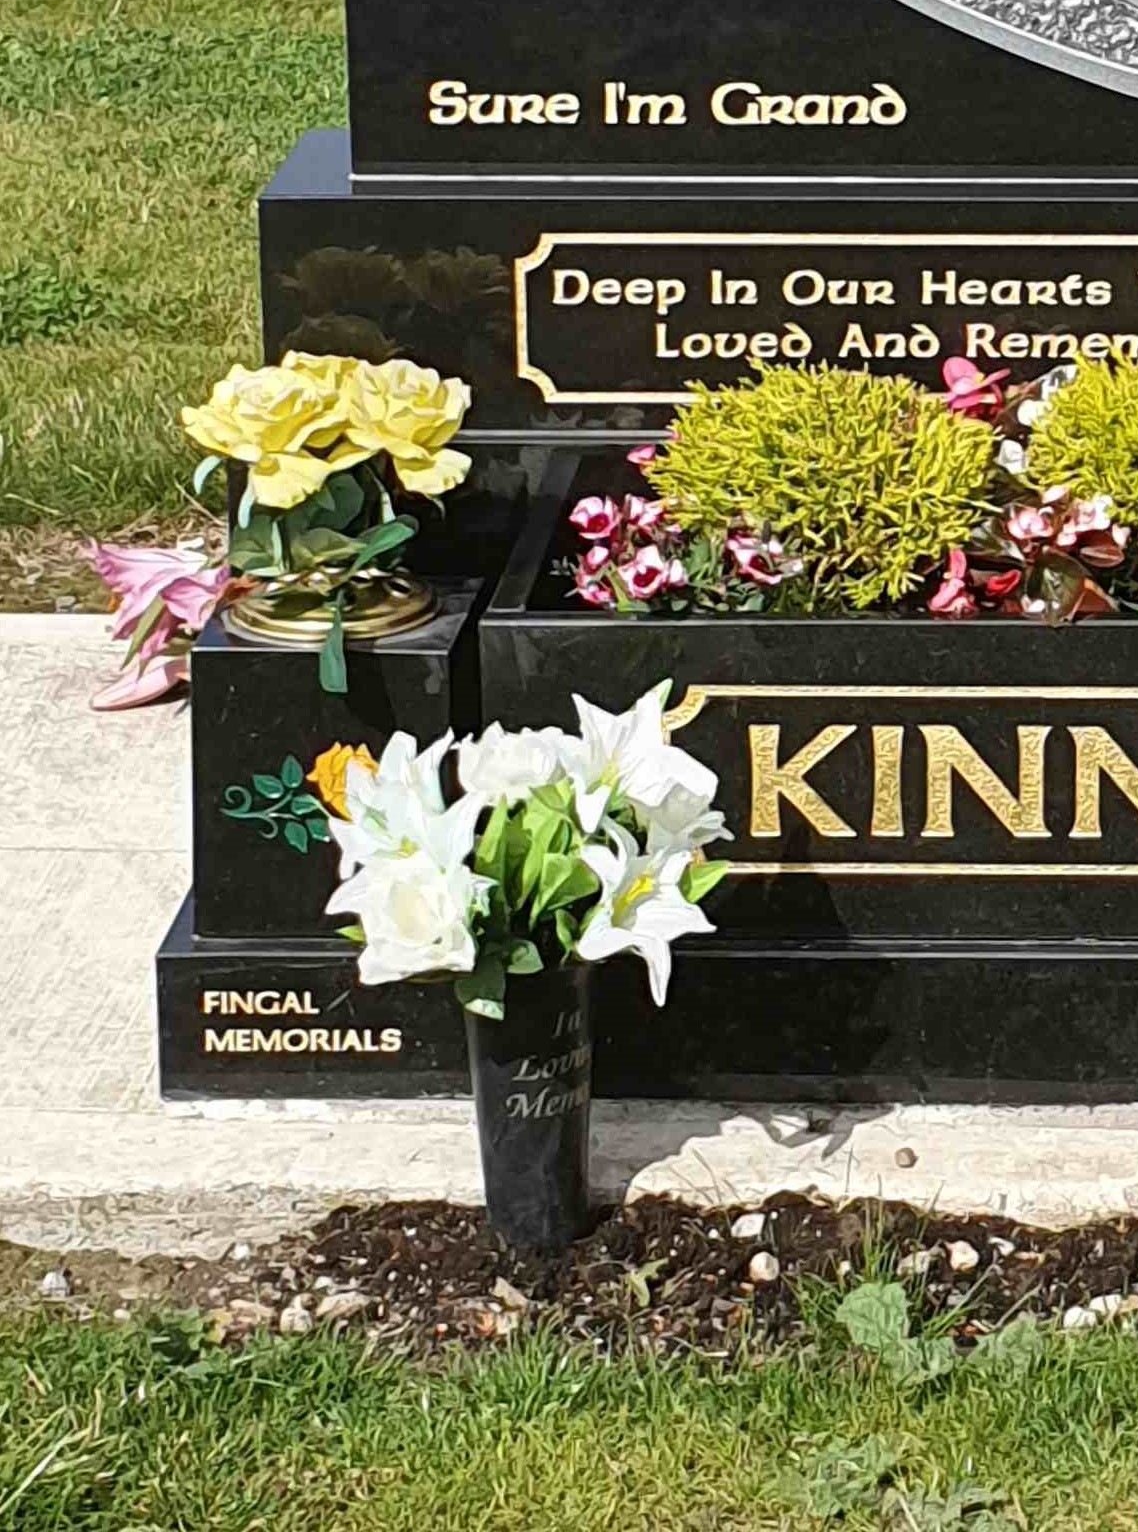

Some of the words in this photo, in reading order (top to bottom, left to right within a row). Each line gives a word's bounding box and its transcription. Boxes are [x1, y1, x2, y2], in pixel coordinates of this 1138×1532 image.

[430, 81, 579, 124] Sure
[605, 82, 686, 124] I'm
[711, 83, 906, 125] Grand
[553, 270, 685, 313] Deep
[712, 270, 758, 304] In
[783, 270, 895, 305] Our
[922, 271, 1111, 305] Hearts
[654, 322, 813, 358] Loved
[838, 324, 938, 357] And
[203, 991, 320, 1015] FINGAL
[205, 1028, 402, 1052] MEMORIALS
